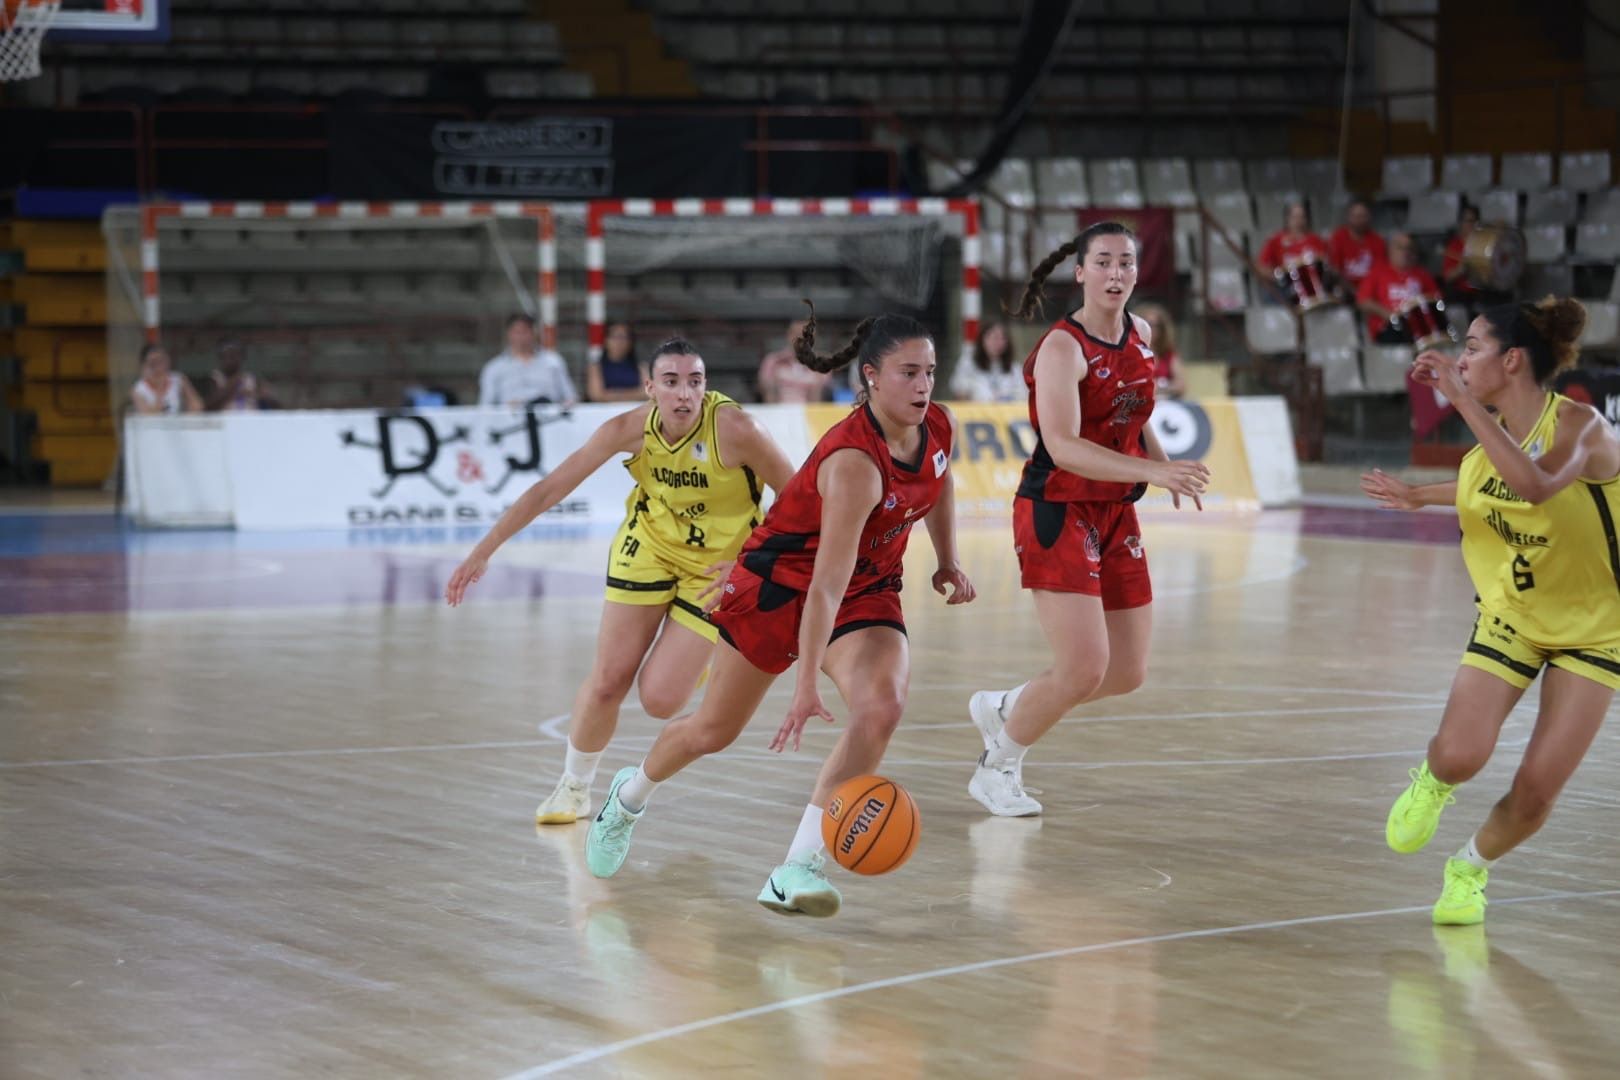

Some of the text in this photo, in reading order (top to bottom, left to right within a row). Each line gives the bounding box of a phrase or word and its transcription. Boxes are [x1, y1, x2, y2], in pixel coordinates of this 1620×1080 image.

[377, 414, 438, 475] D
[650, 466, 709, 488] LCORCÓN
[840, 798, 885, 854] Wilson
